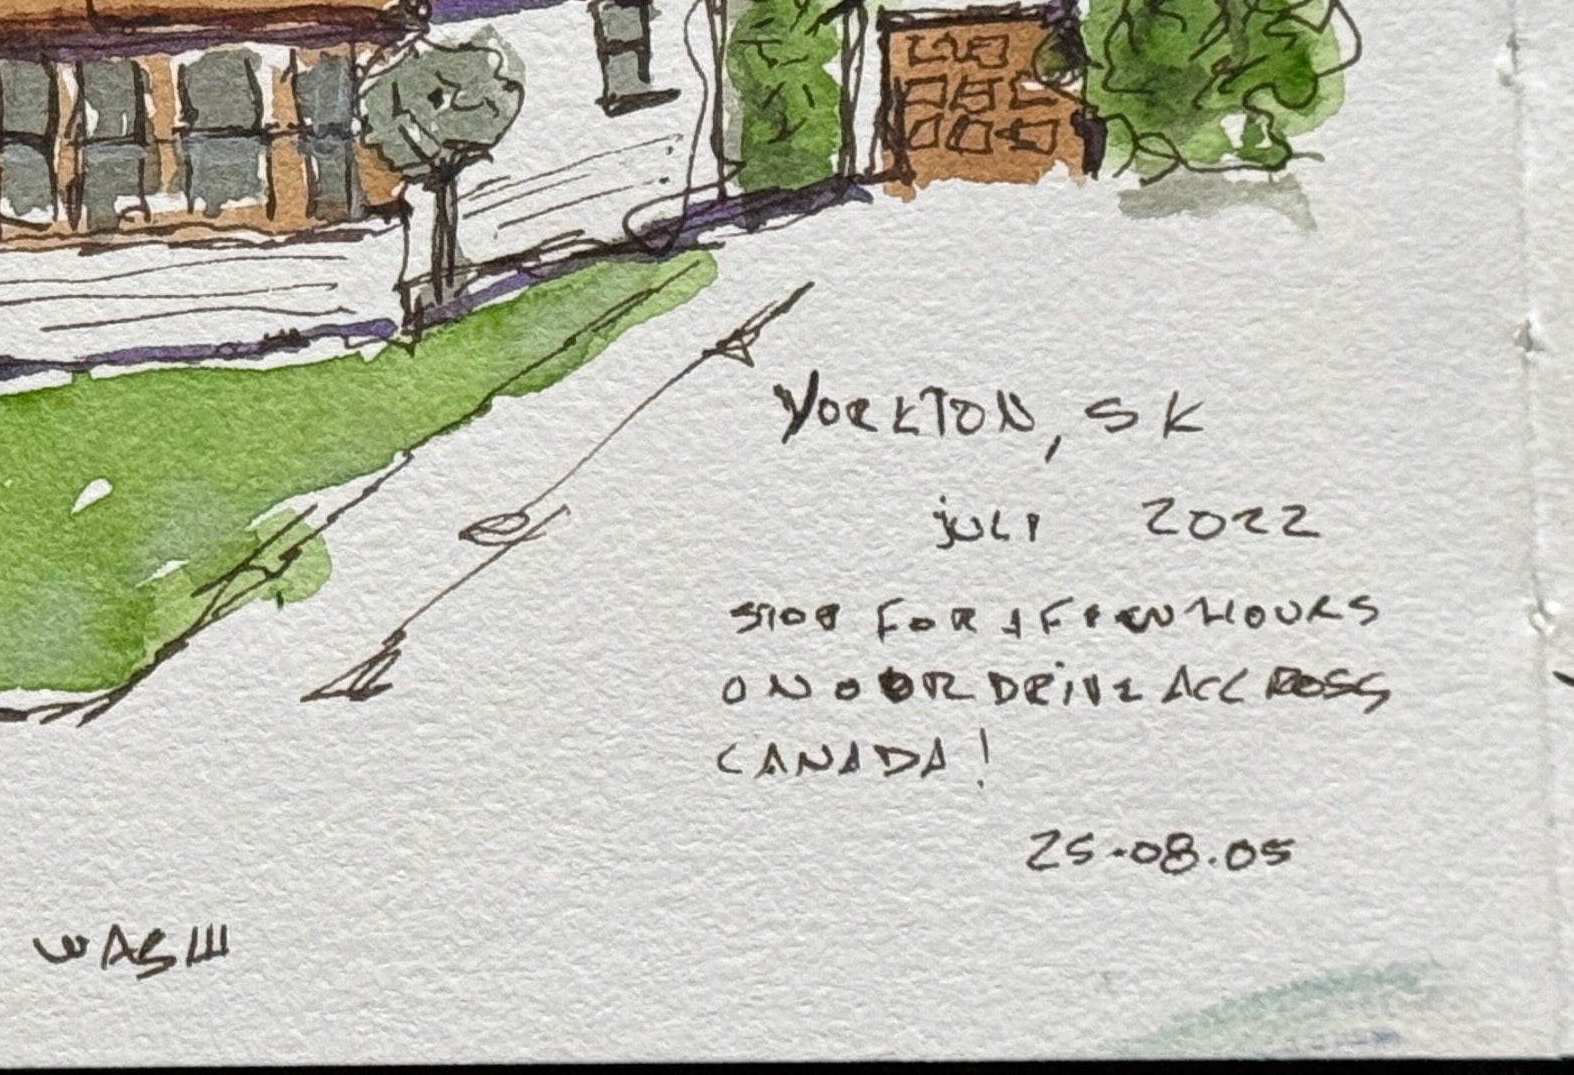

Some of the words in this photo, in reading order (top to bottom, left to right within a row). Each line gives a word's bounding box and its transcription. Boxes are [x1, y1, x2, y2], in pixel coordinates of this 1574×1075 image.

[1140, 496, 1321, 541] 2022
[876, 597, 978, 644] FOR
[1194, 594, 1380, 630] HOURS
[721, 674, 813, 706] ON
